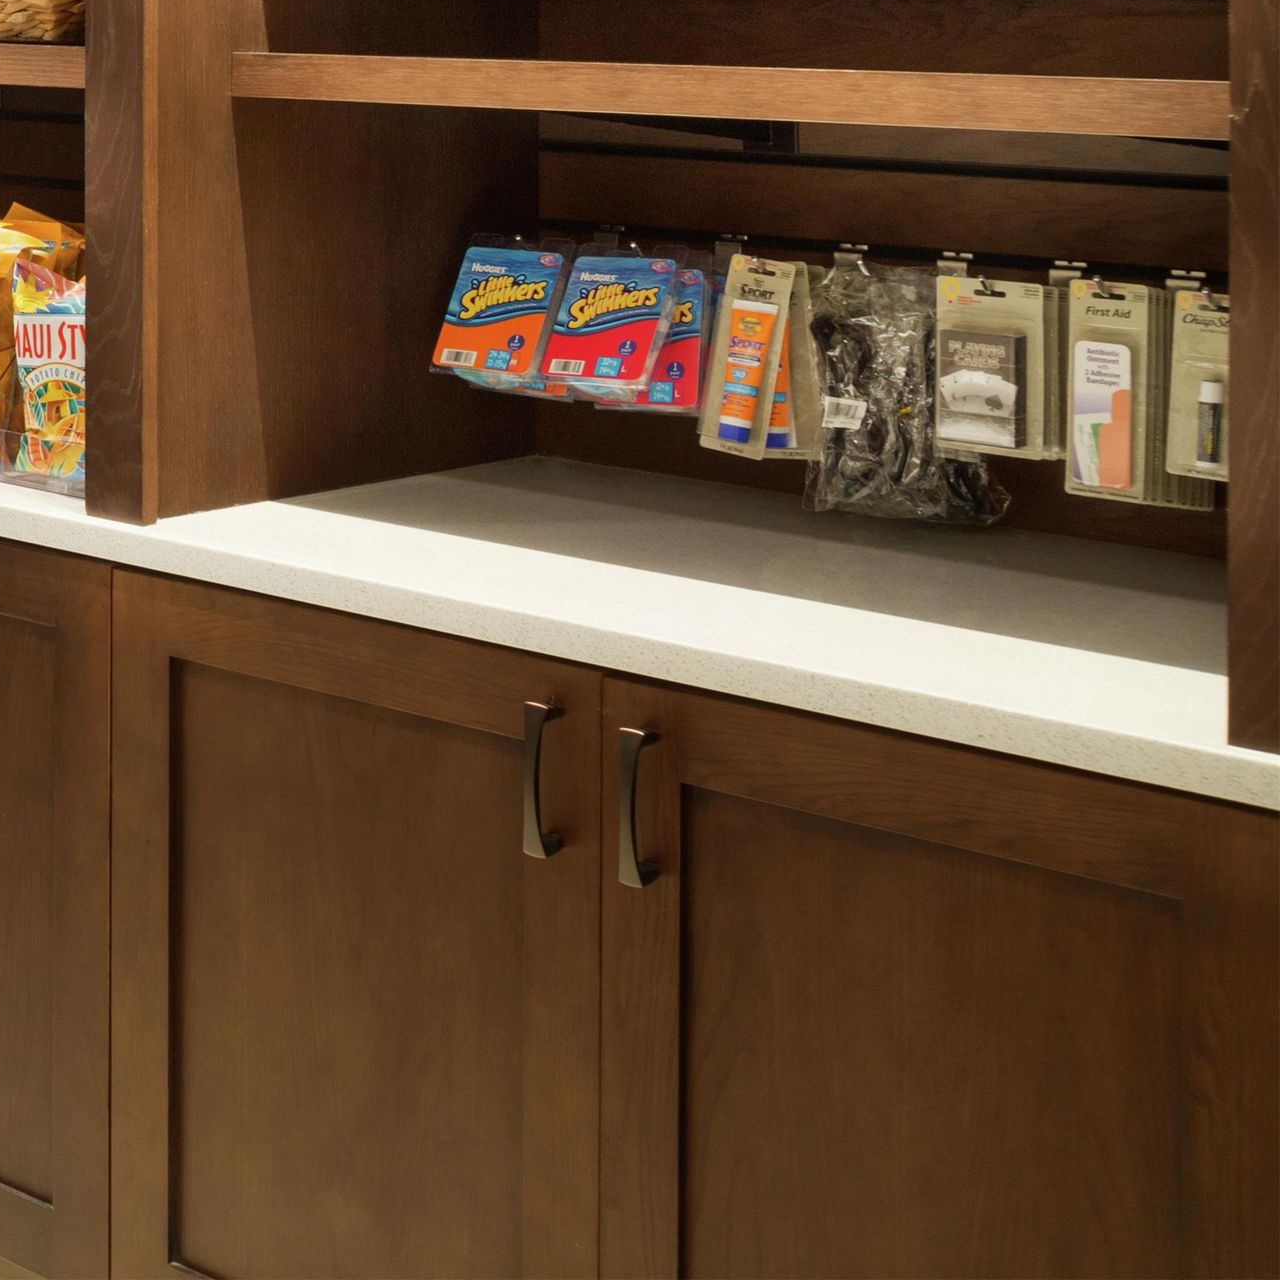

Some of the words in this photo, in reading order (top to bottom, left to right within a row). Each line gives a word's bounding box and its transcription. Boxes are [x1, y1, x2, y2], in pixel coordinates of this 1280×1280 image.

[471, 263, 508, 274] HUGGIES
[580, 272, 617, 282] HUGGIES
[740, 283, 776, 299] SPORT
[1085, 305, 1110, 318] First
[1111, 308, 1132, 319] Aid
[729, 335, 766, 350] SPORT
[948, 339, 1006, 358] PLAYING
[1086, 347, 1119, 357] Antibiotic
[953, 352, 1001, 369] CARDS
[1086, 355, 1119, 365] Ointment
[29, 367, 59, 385] POTATO
[1093, 370, 1121, 379] Adhesive
[1086, 377, 1119, 387] Bandages
